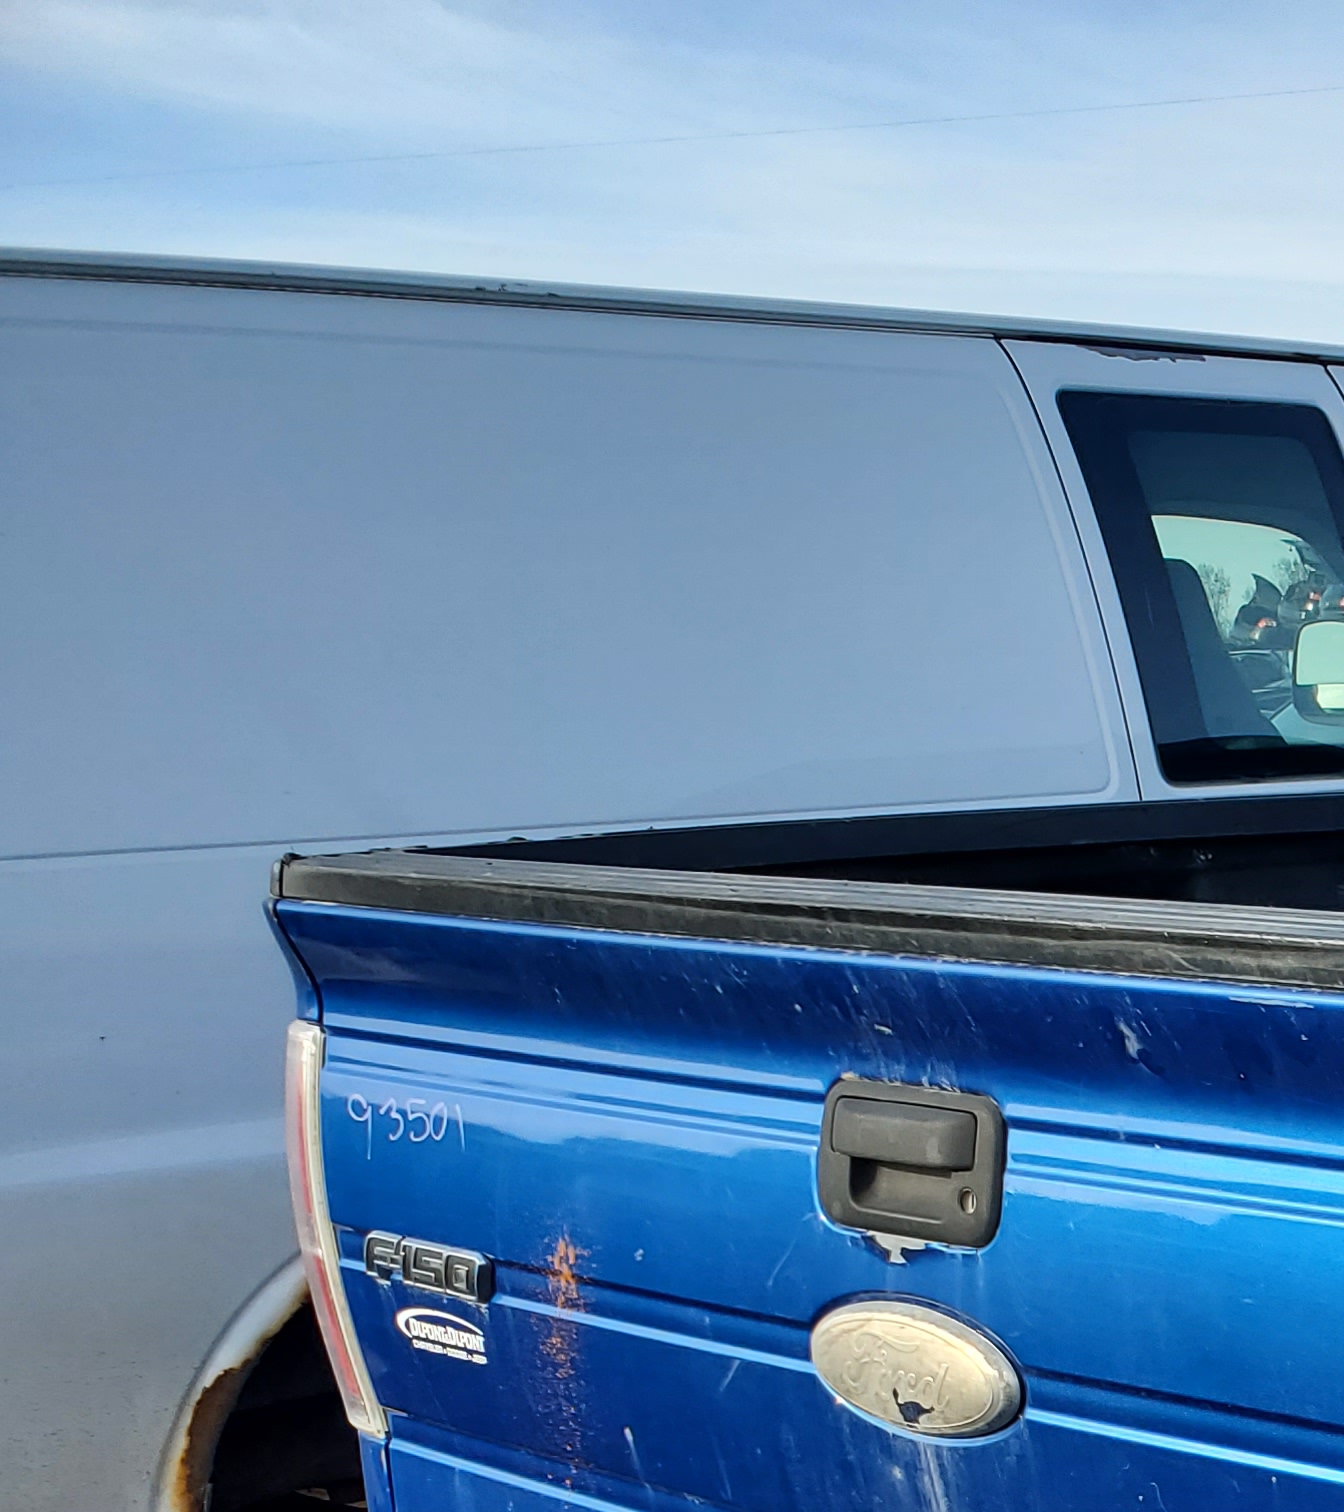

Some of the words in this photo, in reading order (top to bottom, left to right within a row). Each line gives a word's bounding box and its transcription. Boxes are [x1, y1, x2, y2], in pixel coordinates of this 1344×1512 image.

[346, 1093, 466, 1161] 93501
[363, 1230, 492, 1303] F-150
[841, 1329, 949, 1413] Ford
